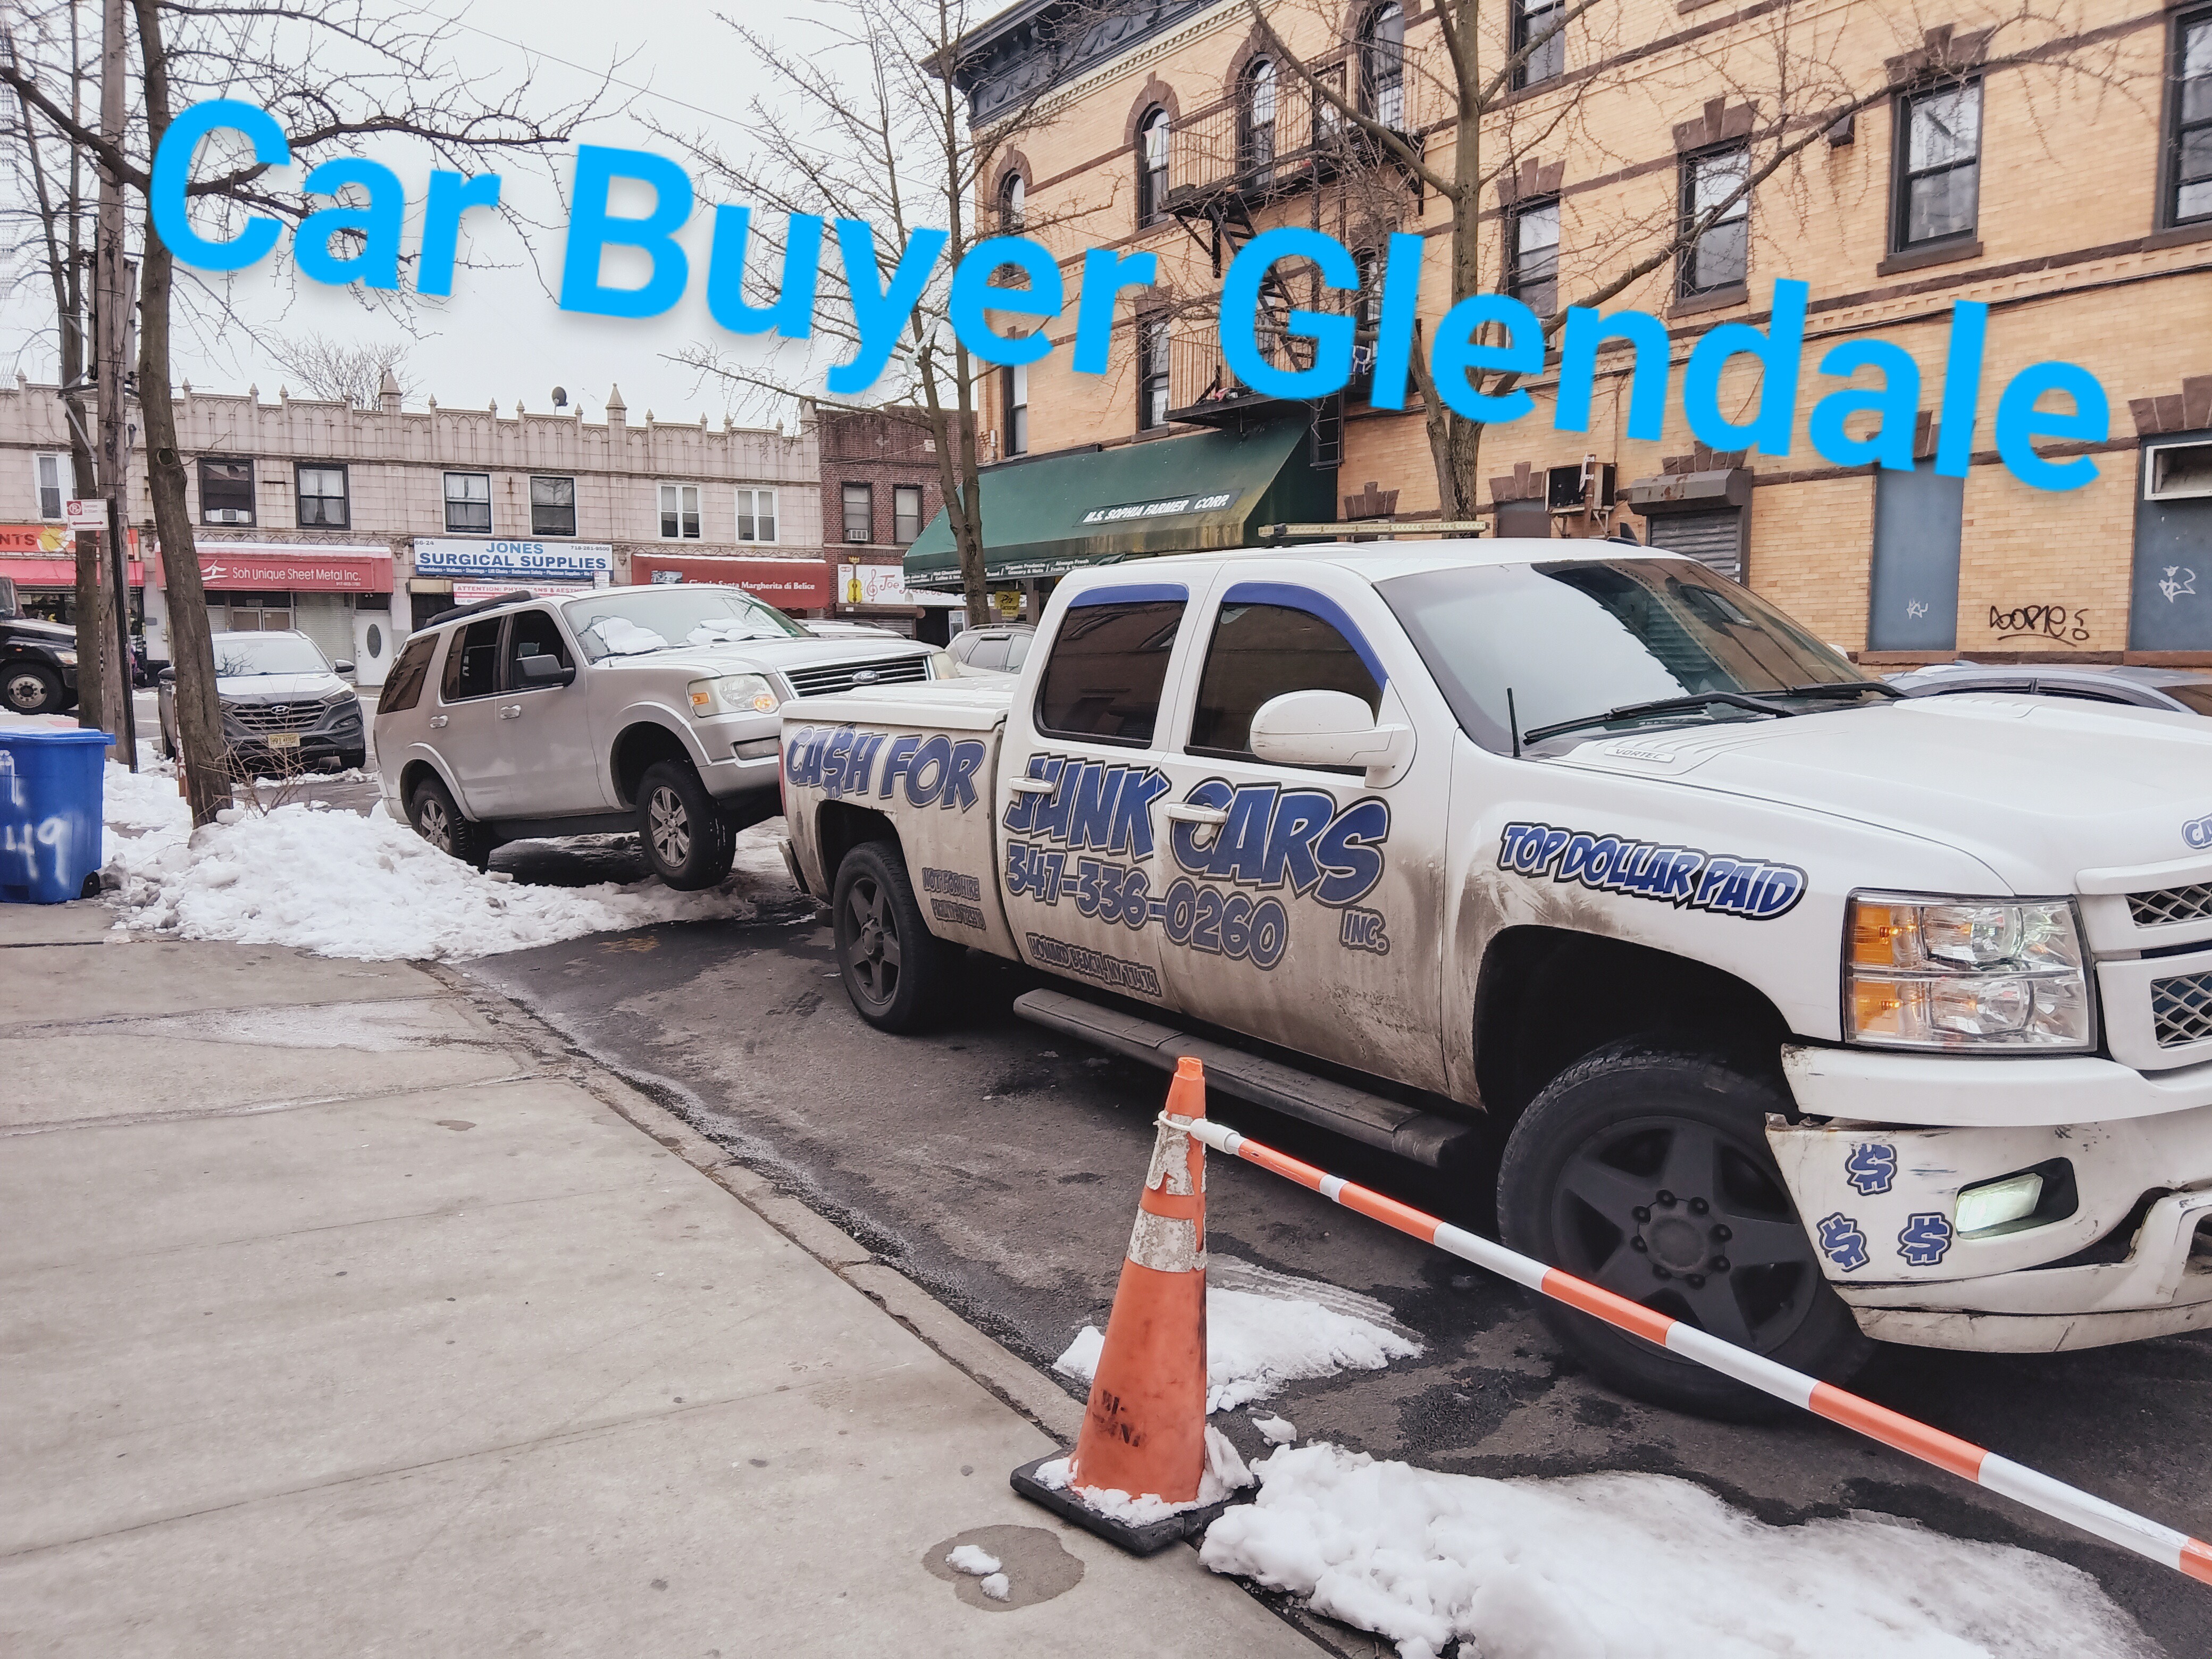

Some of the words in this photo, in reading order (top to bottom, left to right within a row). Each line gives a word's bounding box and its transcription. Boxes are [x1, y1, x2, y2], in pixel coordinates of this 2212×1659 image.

[1104, 505, 1145, 520] SOPHIA
[1142, 500, 1189, 516] FARMER
[485, 542, 543, 554] JONES
[420, 552, 514, 566] SURGICAL
[521, 555, 606, 569] SUPPLIES
[233, 567, 250, 579] Soh
[252, 568, 286, 581] Unique
[288, 568, 314, 580] Sheet
[316, 569, 342, 581] Metal
[345, 569, 362, 581] Inc.
[878, 574, 900, 591] Joe
[741, 581, 783, 590] Margherita
[1616, 749, 1665, 759] VORTEC
[879, 733, 986, 811] FOR
[1003, 753, 1171, 861] JUNK
[1169, 777, 1392, 909] CARS
[1497, 822, 1568, 878] TOP
[1554, 831, 1704, 910] DOLLAR
[1686, 854, 1809, 921] PAID
[1006, 839, 1288, 970] 347-336-0260
[1339, 905, 1390, 956] INC.
[1026, 932, 1071, 969] HOWARD
